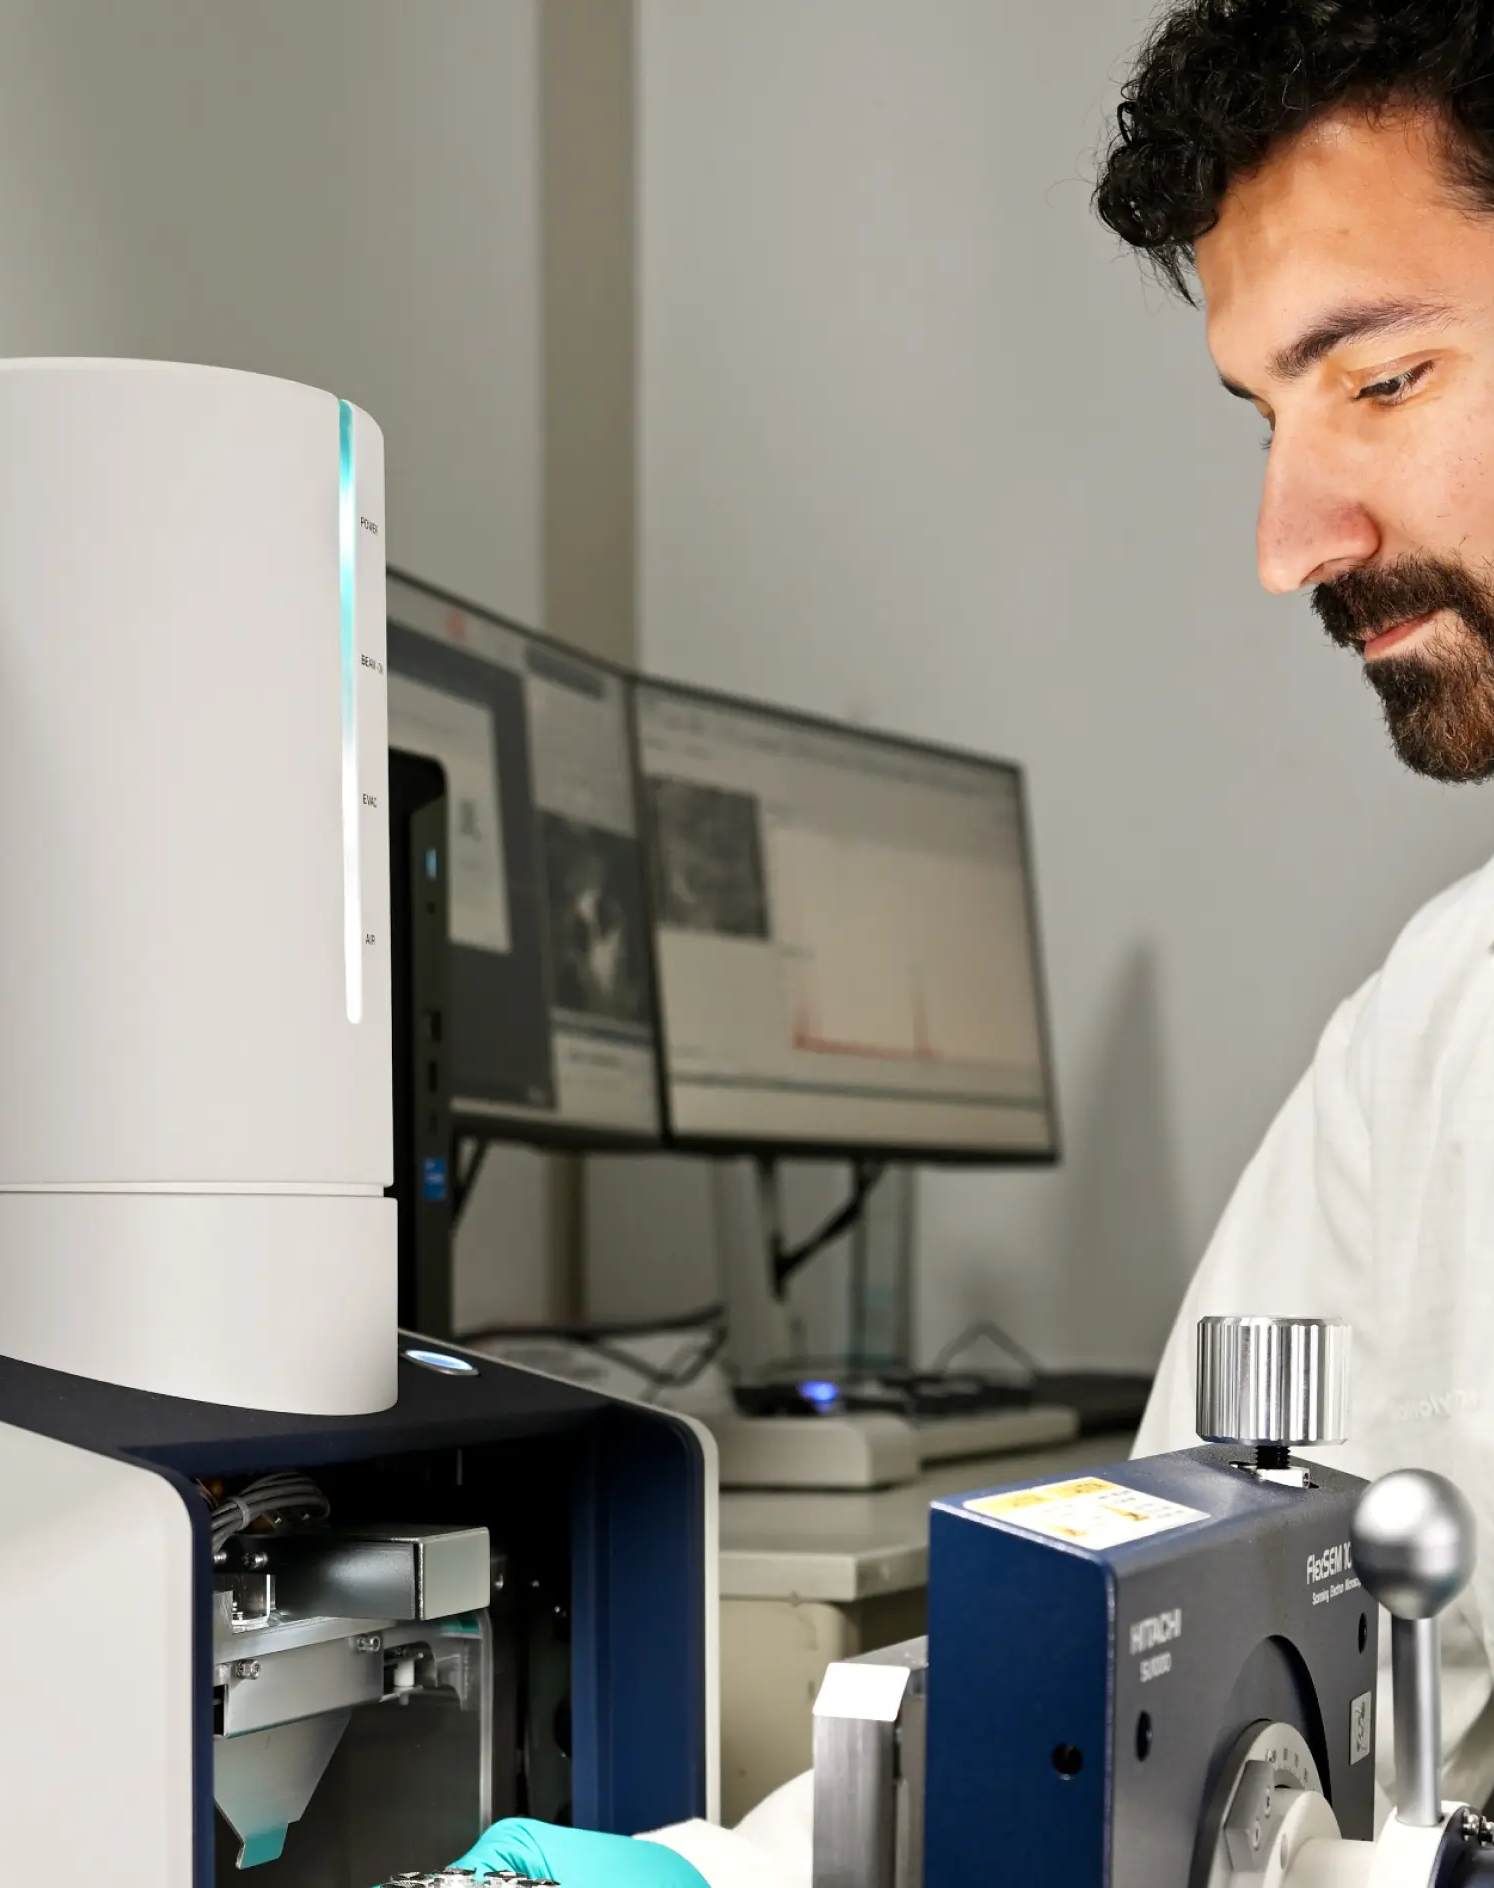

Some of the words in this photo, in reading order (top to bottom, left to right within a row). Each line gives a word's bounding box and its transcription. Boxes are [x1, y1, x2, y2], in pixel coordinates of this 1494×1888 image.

[360, 516, 378, 536] POWER
[365, 933, 376, 946] AIR
[1306, 1544, 1342, 1585] FlexSEM
[1311, 1589, 1329, 1606] Scanning
[1129, 1608, 1182, 1656] HITACHI
